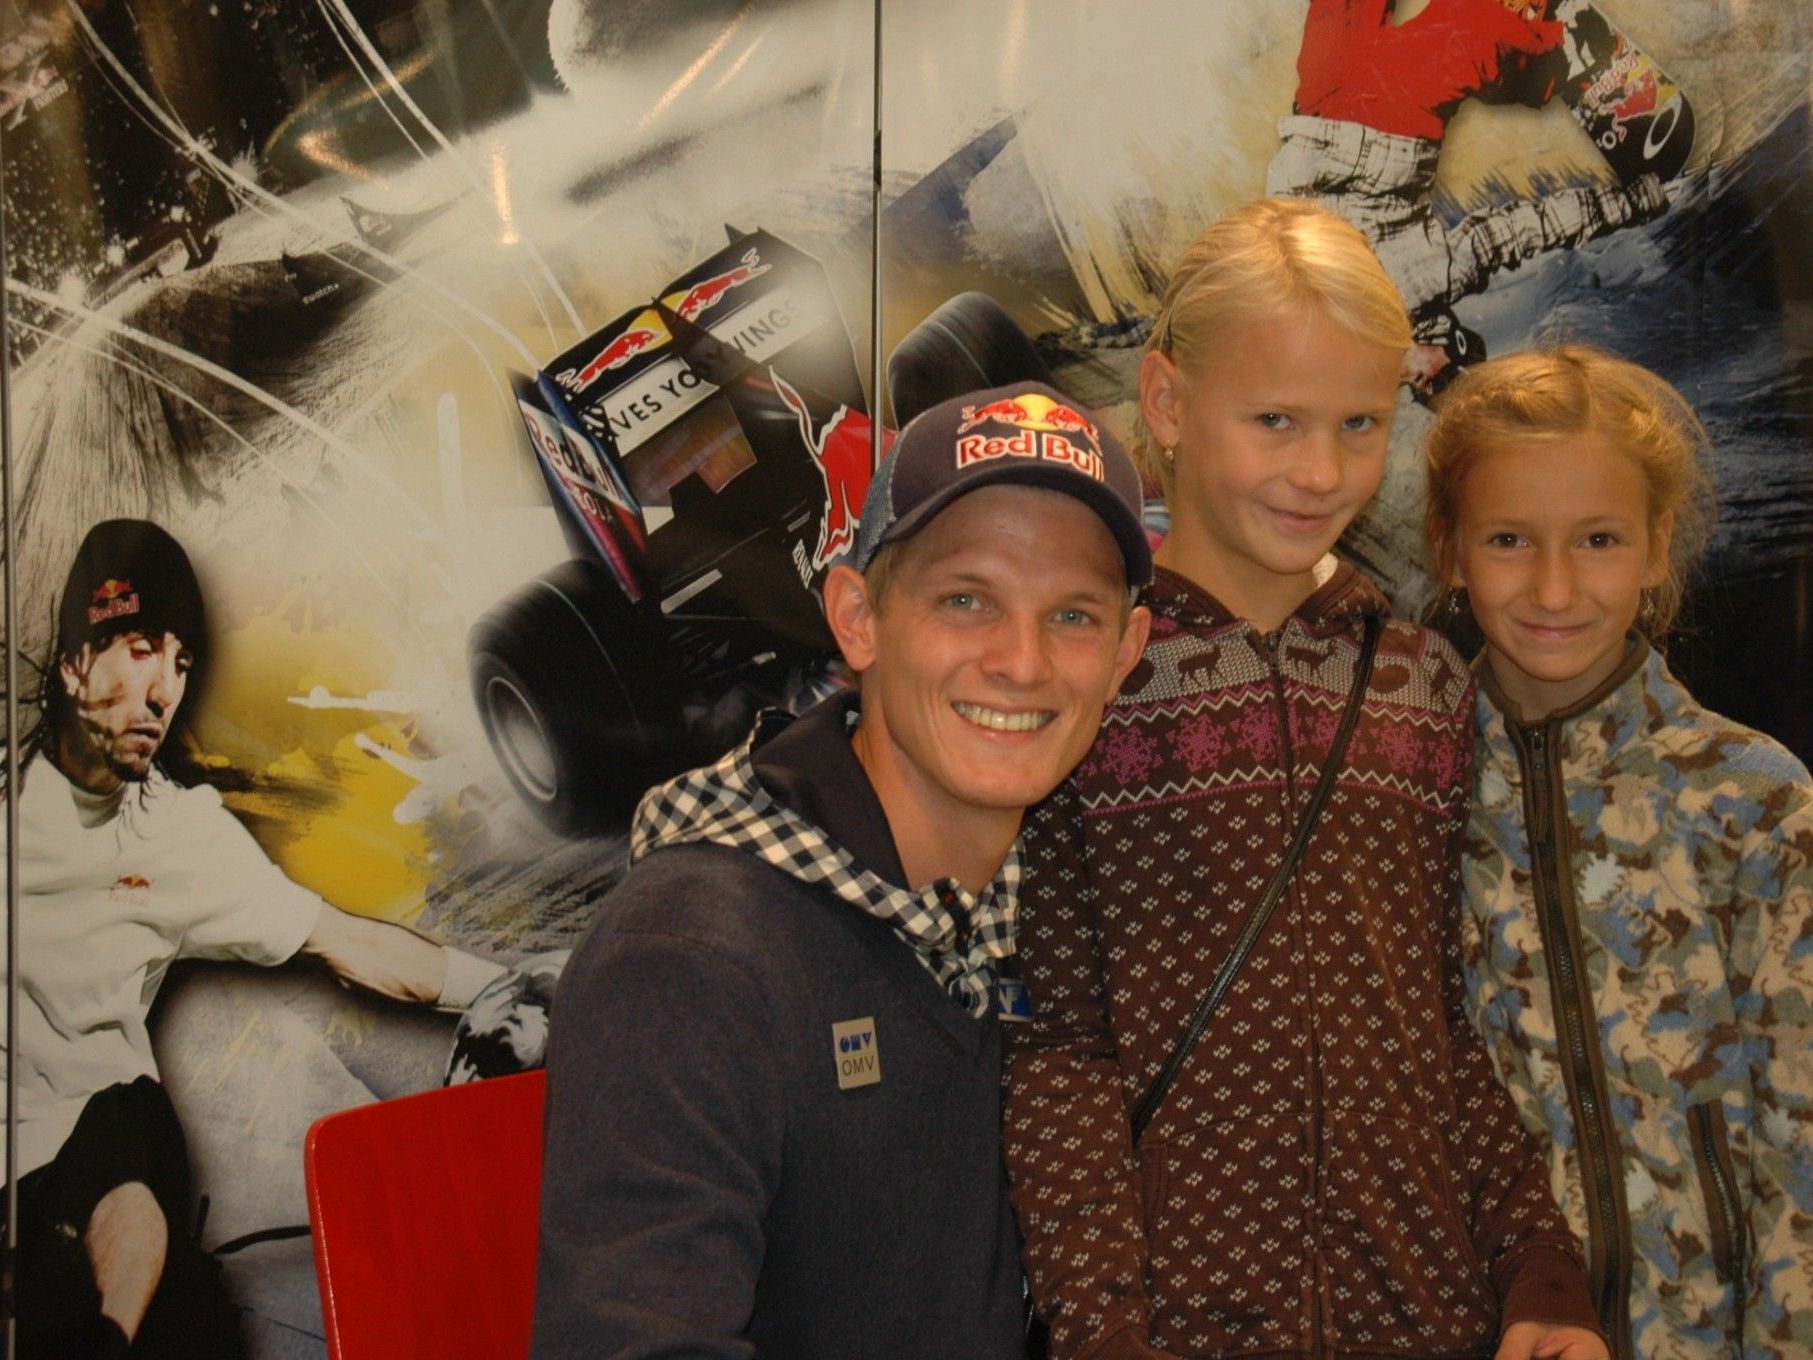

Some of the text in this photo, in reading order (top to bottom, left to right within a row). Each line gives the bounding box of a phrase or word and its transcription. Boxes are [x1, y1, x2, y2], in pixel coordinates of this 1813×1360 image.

[956, 429, 1105, 482] Red Bull
[88, 592, 140, 625] Red Bull
[841, 1055, 875, 1076] OMV
